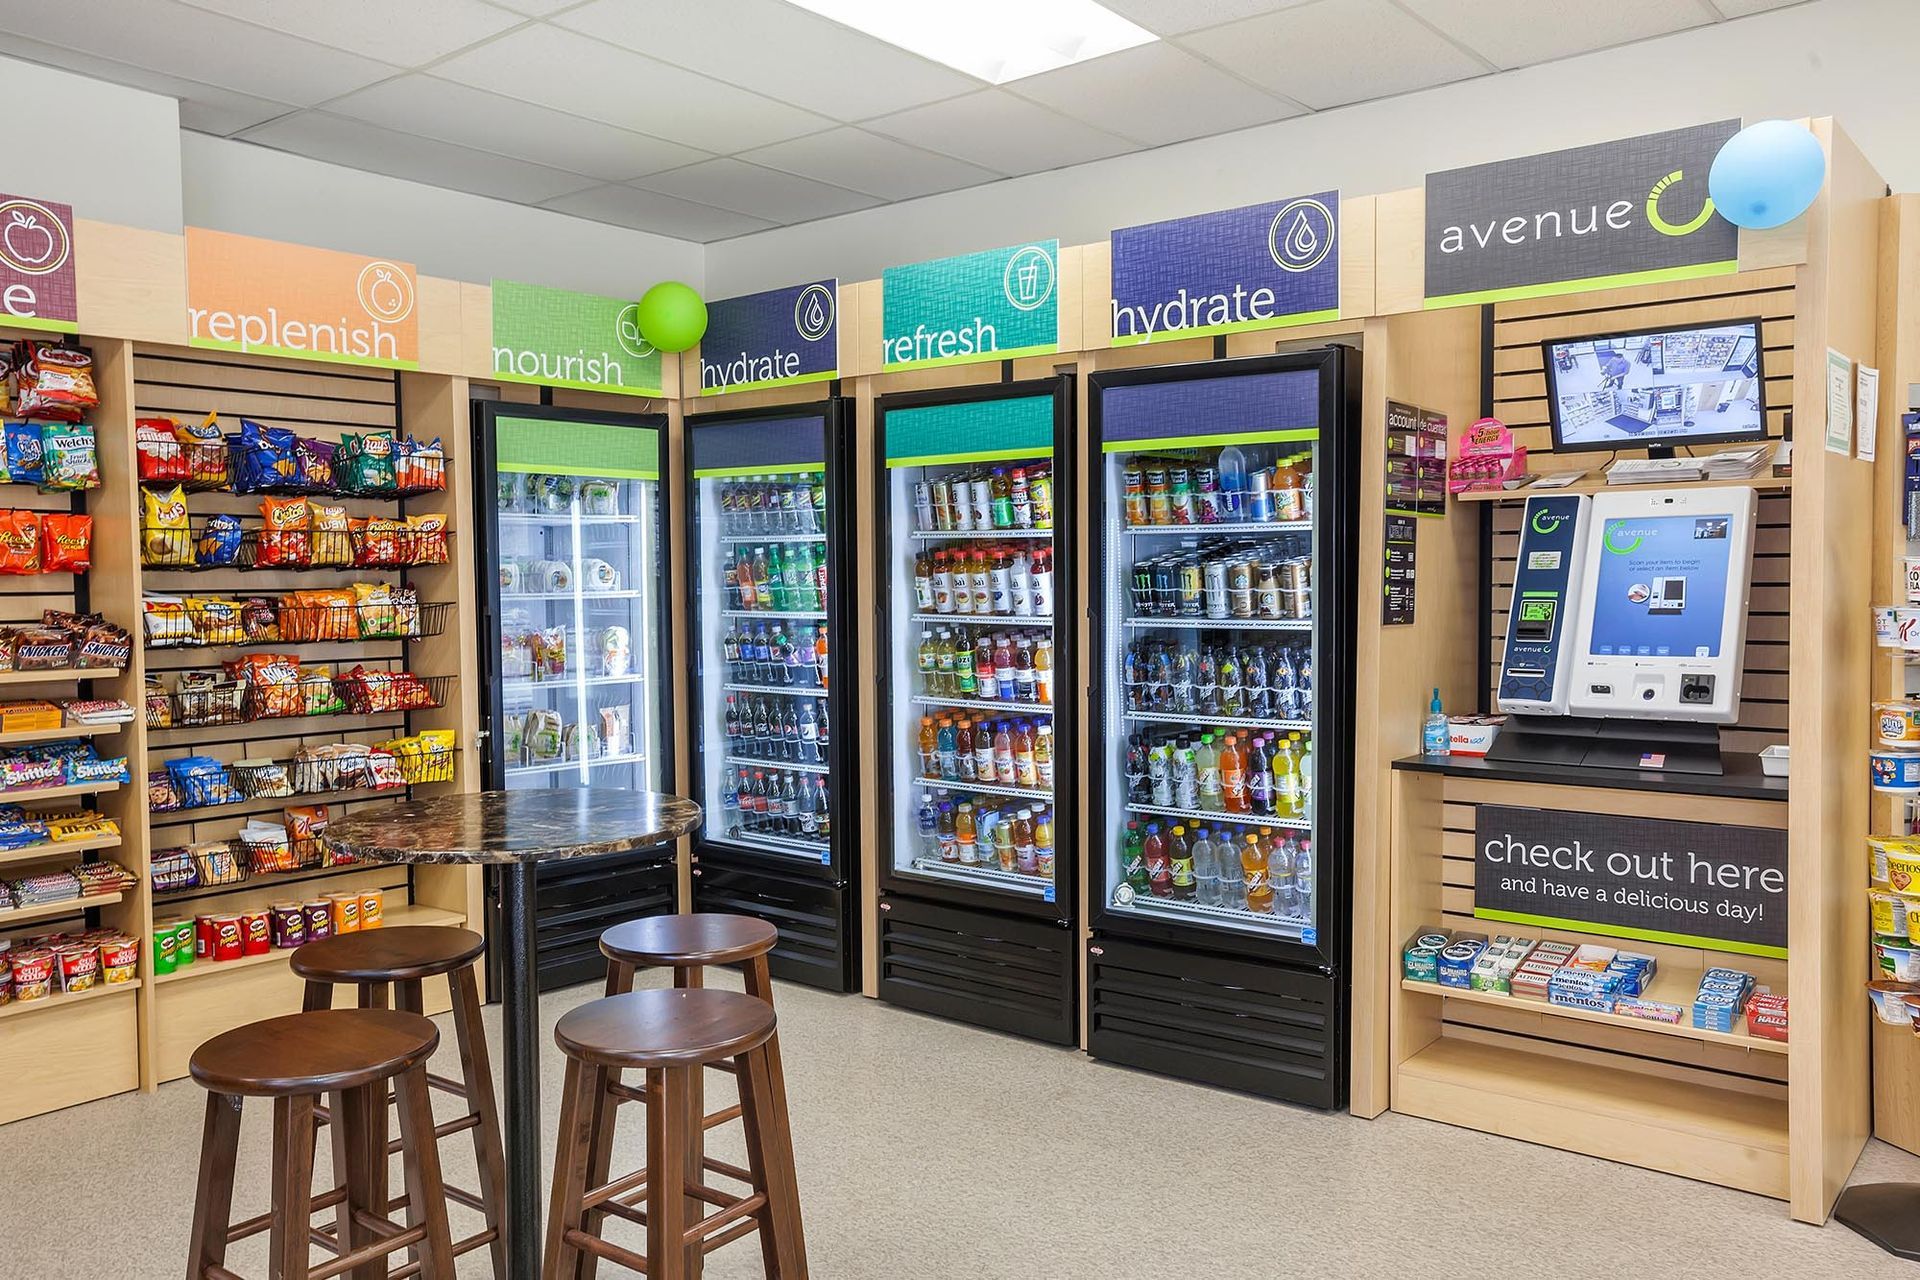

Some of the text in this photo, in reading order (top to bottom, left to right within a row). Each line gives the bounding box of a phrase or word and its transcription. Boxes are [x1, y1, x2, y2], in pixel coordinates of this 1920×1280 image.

[1440, 200, 1634, 254] avenue
[3, 283, 36, 318] e
[1112, 284, 1275, 345] hydrate
[188, 307, 399, 361] replenish
[883, 317, 998, 365] refresh
[493, 346, 624, 387] nourish
[700, 349, 800, 395] hydrate
[1389, 414, 1417, 431] account
[55, 437, 95, 449] Welch's
[1909, 582, 1920, 590] FLA
[1450, 736, 1469, 744] tella
[5, 765, 61, 785] Skittles
[76, 764, 126, 779] Skittles
[1484, 834, 1784, 894] check out here
[1500, 876, 1764, 924] and have a delicious day!
[1542, 943, 1572, 951] ALTOIDS
[1533, 952, 1564, 961] ALTOIDS
[1525, 962, 1556, 972] ALTOIDS
[1708, 970, 1744, 979] Extra
[1517, 974, 1548, 982] ALTOIDS
[1555, 977, 1590, 987] mentos
[1703, 981, 1738, 991] Extra
[1554, 994, 1606, 1009] mentos
[1697, 993, 1734, 1003] Extra
[1757, 1015, 1787, 1026] HALLS
